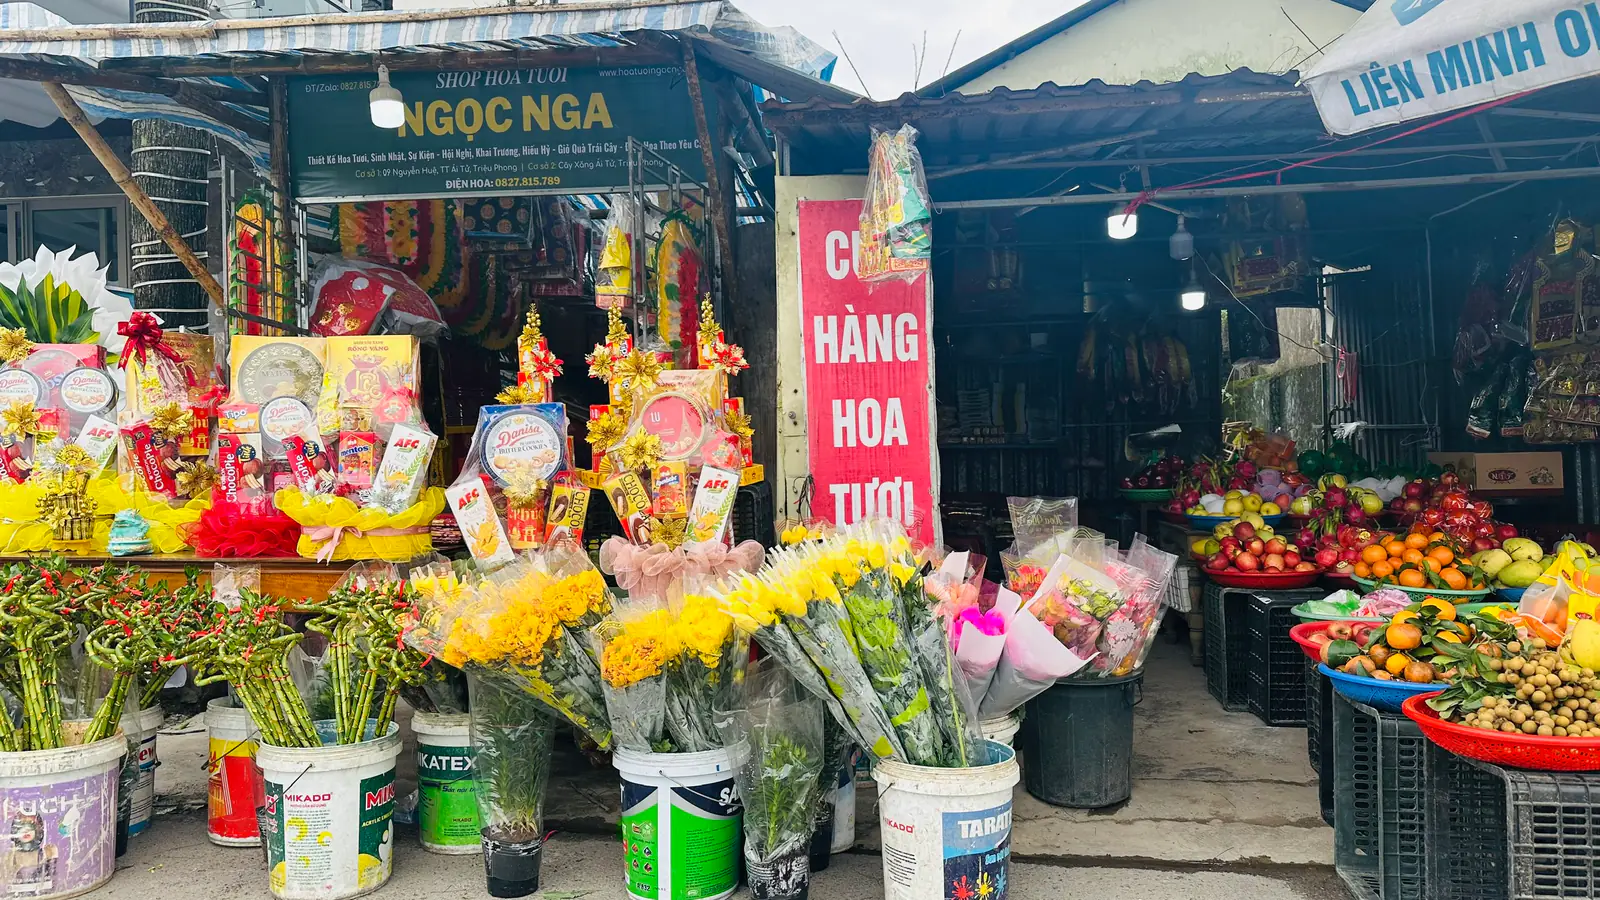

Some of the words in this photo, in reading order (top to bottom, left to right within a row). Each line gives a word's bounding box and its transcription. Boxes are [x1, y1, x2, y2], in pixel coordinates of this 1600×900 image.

[1340, 59, 1424, 116] LIÊN
[1426, 21, 1546, 95] MINH
[436, 70, 481, 88] SHOP
[485, 69, 521, 86] HOA
[398, 96, 513, 142] NGỌC
[521, 92, 614, 131] NGA
[337, 155, 351, 164] Hoa
[371, 153, 386, 163] Sinh
[475, 148, 492, 157] Khai
[659, 140, 677, 150] Theo
[382, 169, 391, 177] 09
[494, 163, 518, 173] Phong
[445, 178, 469, 190] ĐIỆN
[470, 179, 494, 188] HOA:
[495, 176, 561, 187] 0827.815.789
[813, 304, 919, 364] HÀNG
[223, 407, 247, 420] Tipo
[831, 397, 909, 448] HOA
[87, 427, 114, 439] AFC
[496, 424, 543, 448] Danisa
[341, 445, 369, 457] mentos
[393, 438, 420, 449] AFC
[703, 480, 729, 489] AFC
[458, 488, 480, 510] AFC
[284, 793, 331, 802] MIKADO
